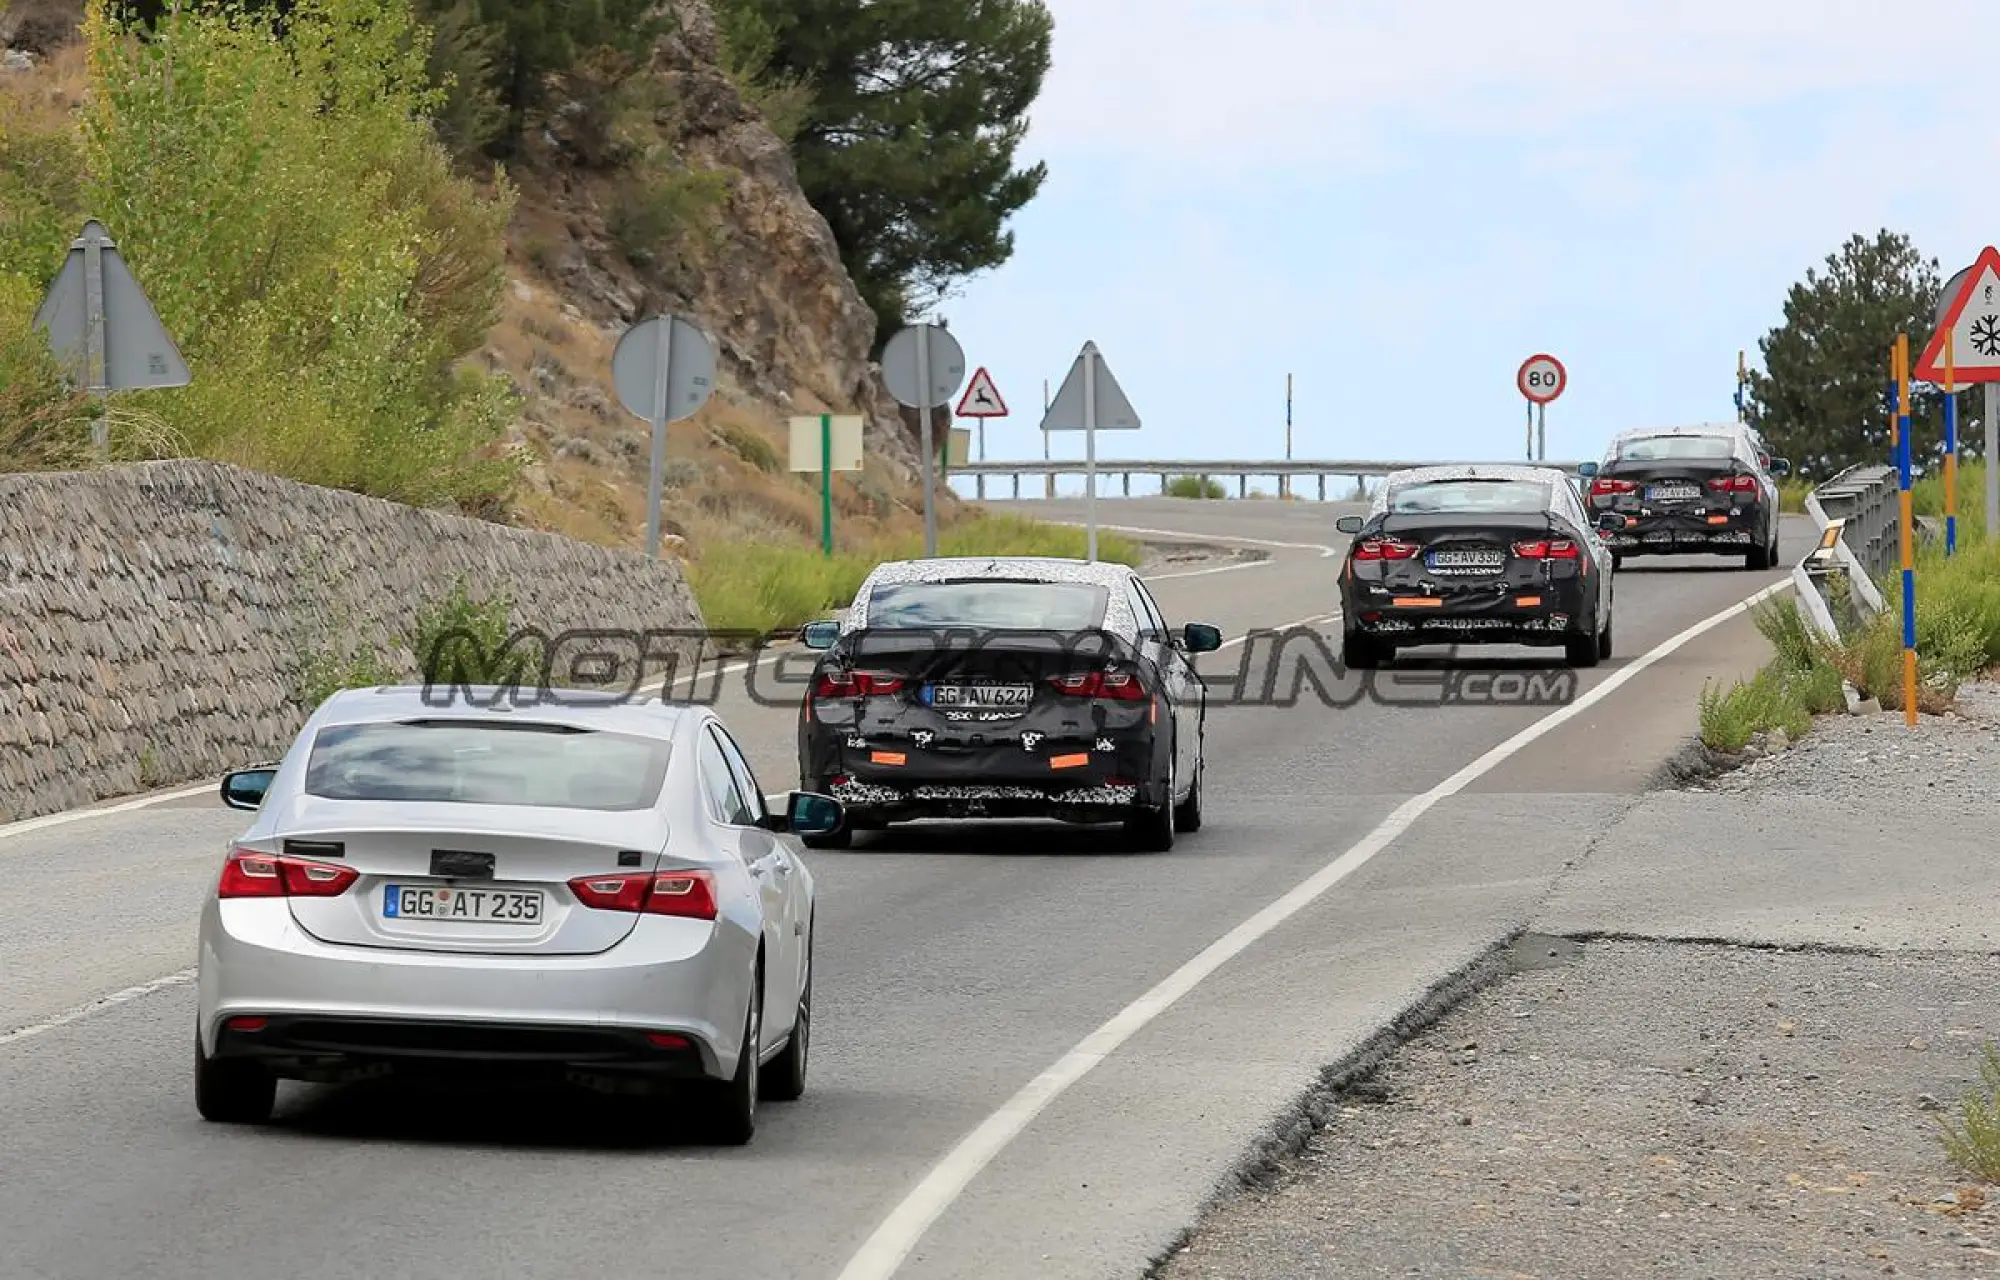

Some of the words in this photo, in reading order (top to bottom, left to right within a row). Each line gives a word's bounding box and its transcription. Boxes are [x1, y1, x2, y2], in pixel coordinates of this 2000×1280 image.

[1529, 372, 1555, 387] 80
[1461, 551, 1476, 563] AV
[934, 687, 957, 704] GG
[969, 688, 991, 705] AV
[994, 689, 1026, 706] 624
[401, 889, 434, 916] GG
[452, 891, 486, 917] AT
[491, 894, 540, 919] 235
